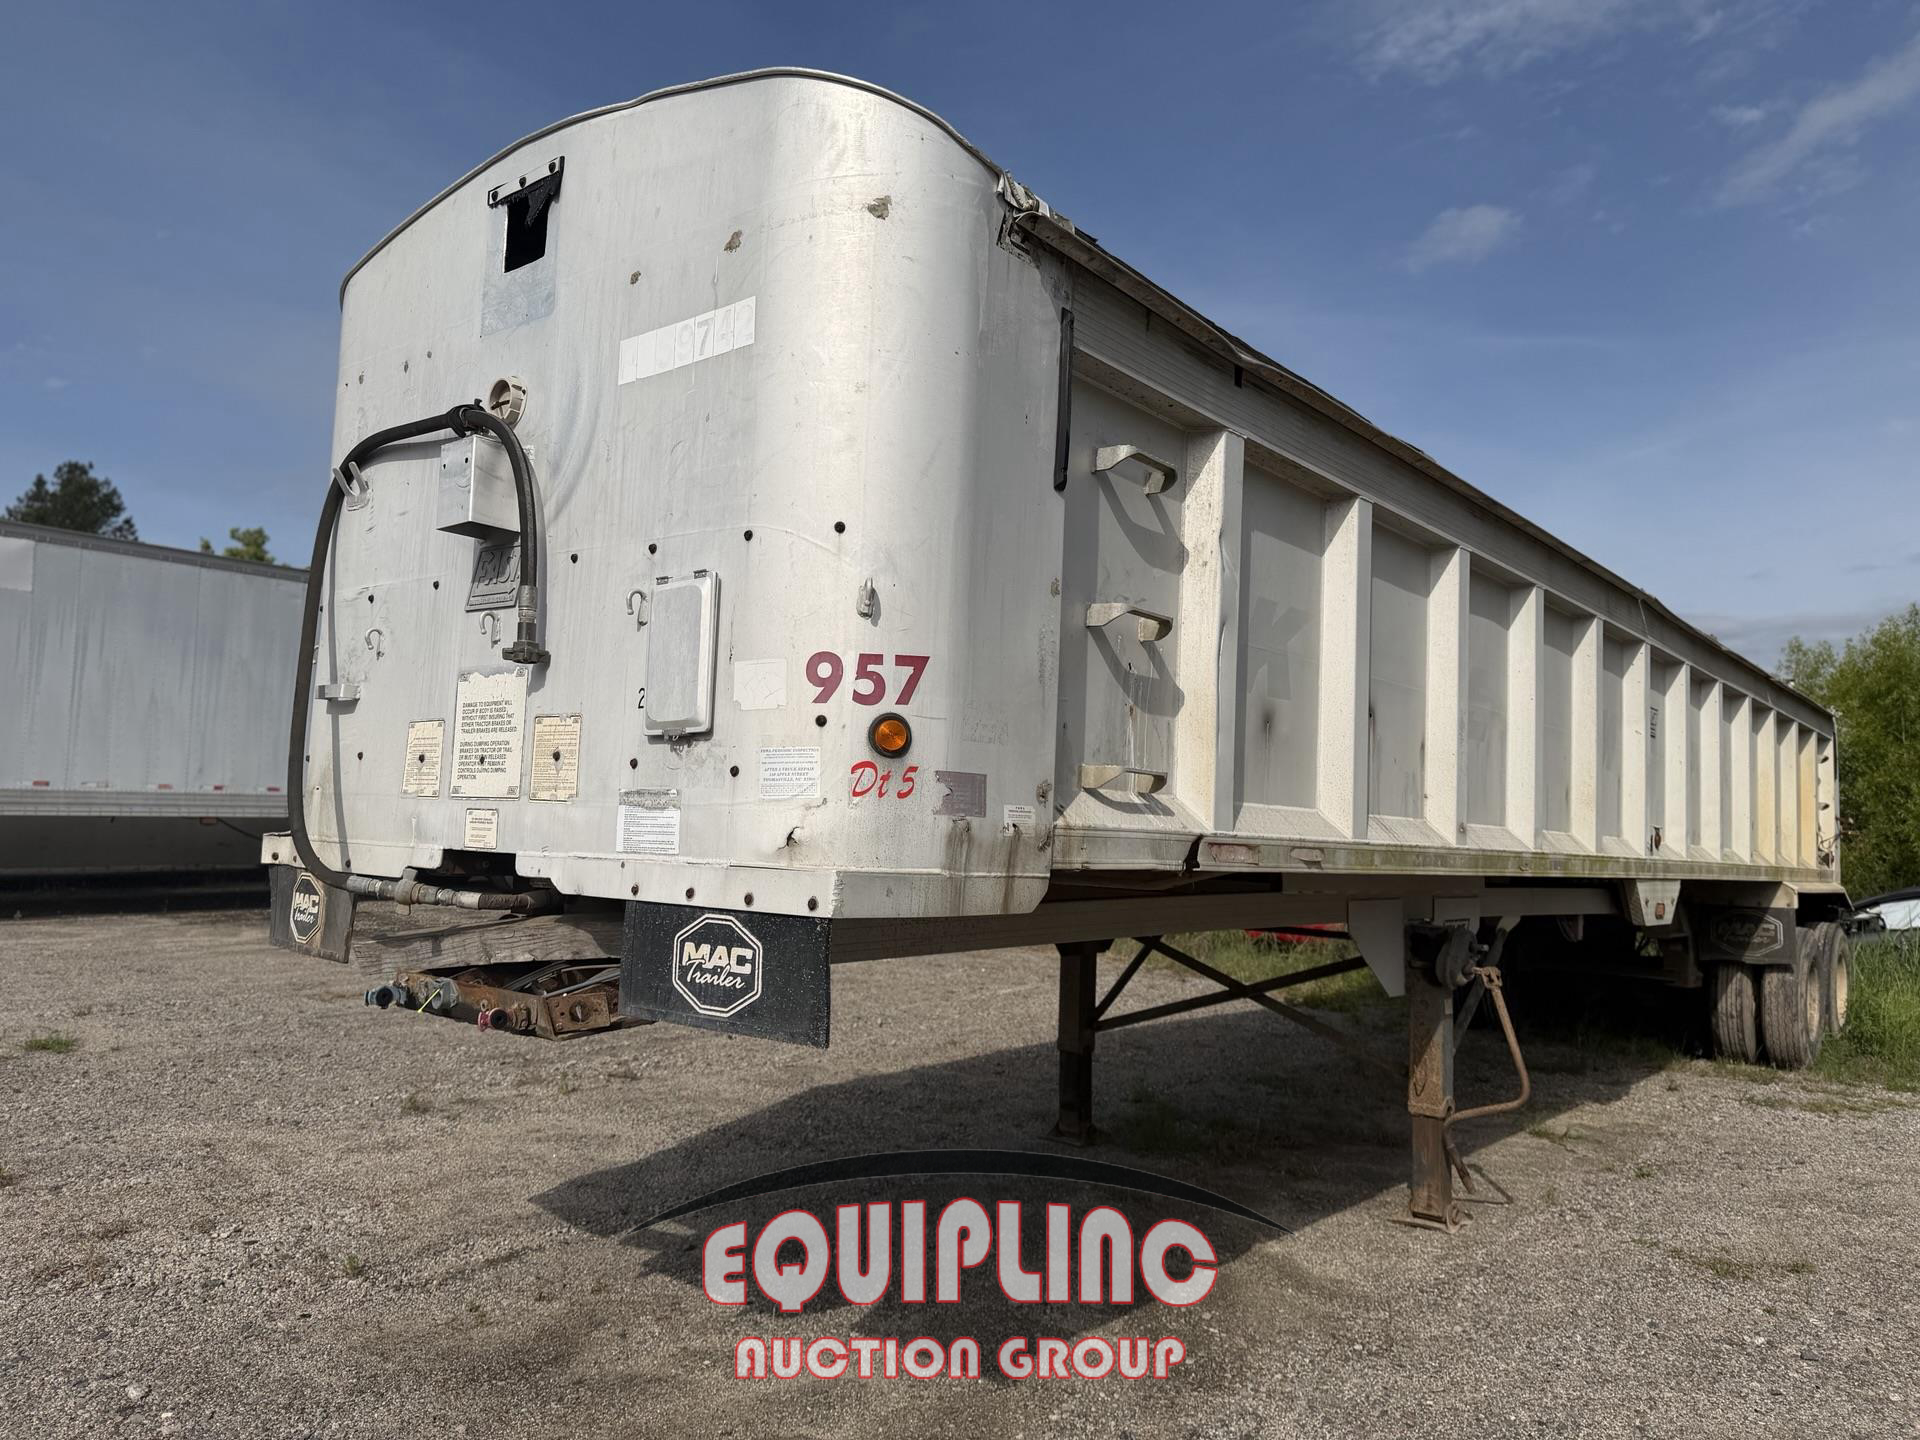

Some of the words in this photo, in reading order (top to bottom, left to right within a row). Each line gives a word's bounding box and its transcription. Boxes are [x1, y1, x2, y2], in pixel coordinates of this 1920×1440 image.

[806, 651, 930, 706] 957
[638, 687, 646, 709] 2
[851, 761, 892, 798] Dt
[897, 766, 919, 799] 5
[294, 892, 320, 913] MAC
[682, 942, 754, 975] MAC
[686, 958, 746, 989] Trailer
